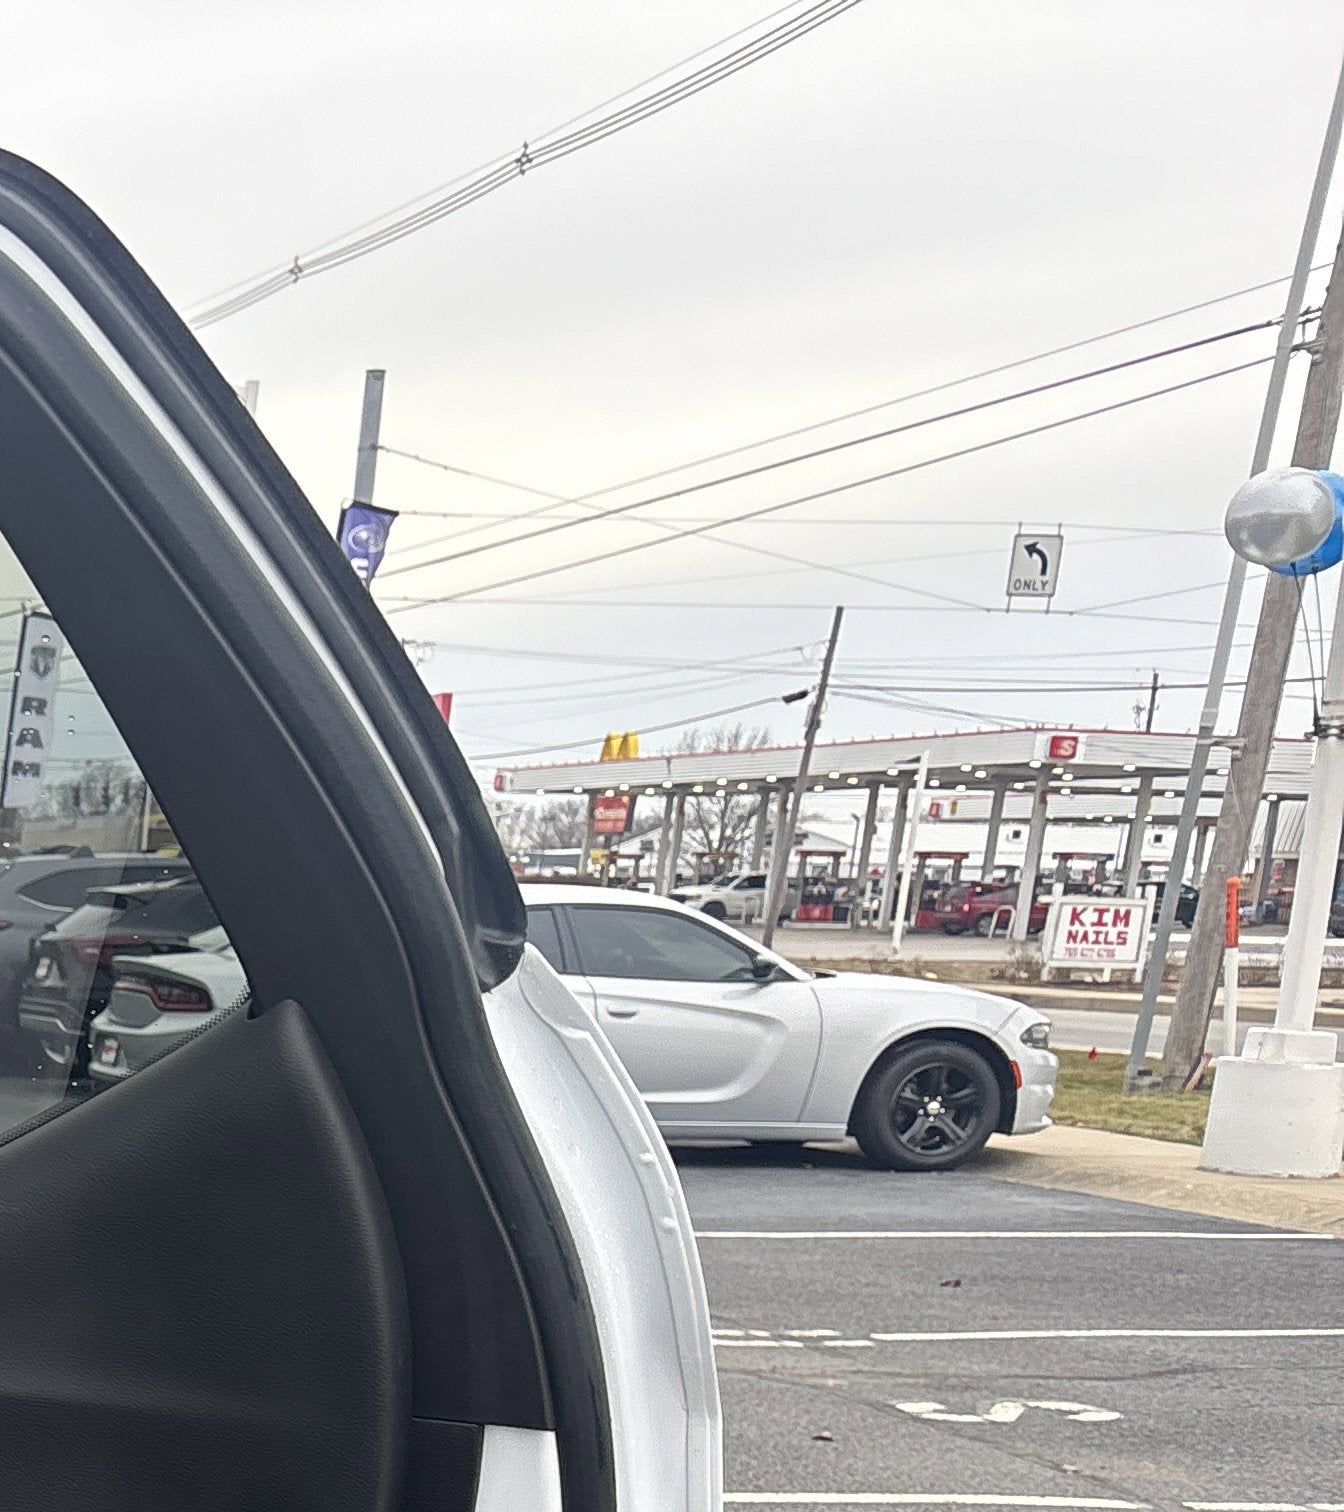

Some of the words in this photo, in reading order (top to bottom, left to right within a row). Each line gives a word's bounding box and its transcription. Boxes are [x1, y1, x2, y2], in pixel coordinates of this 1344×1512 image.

[1014, 579, 1048, 591] ONLY
[12, 697, 47, 777] RAM
[1069, 906, 1132, 928] KIM
[1066, 930, 1128, 945] NAILS
